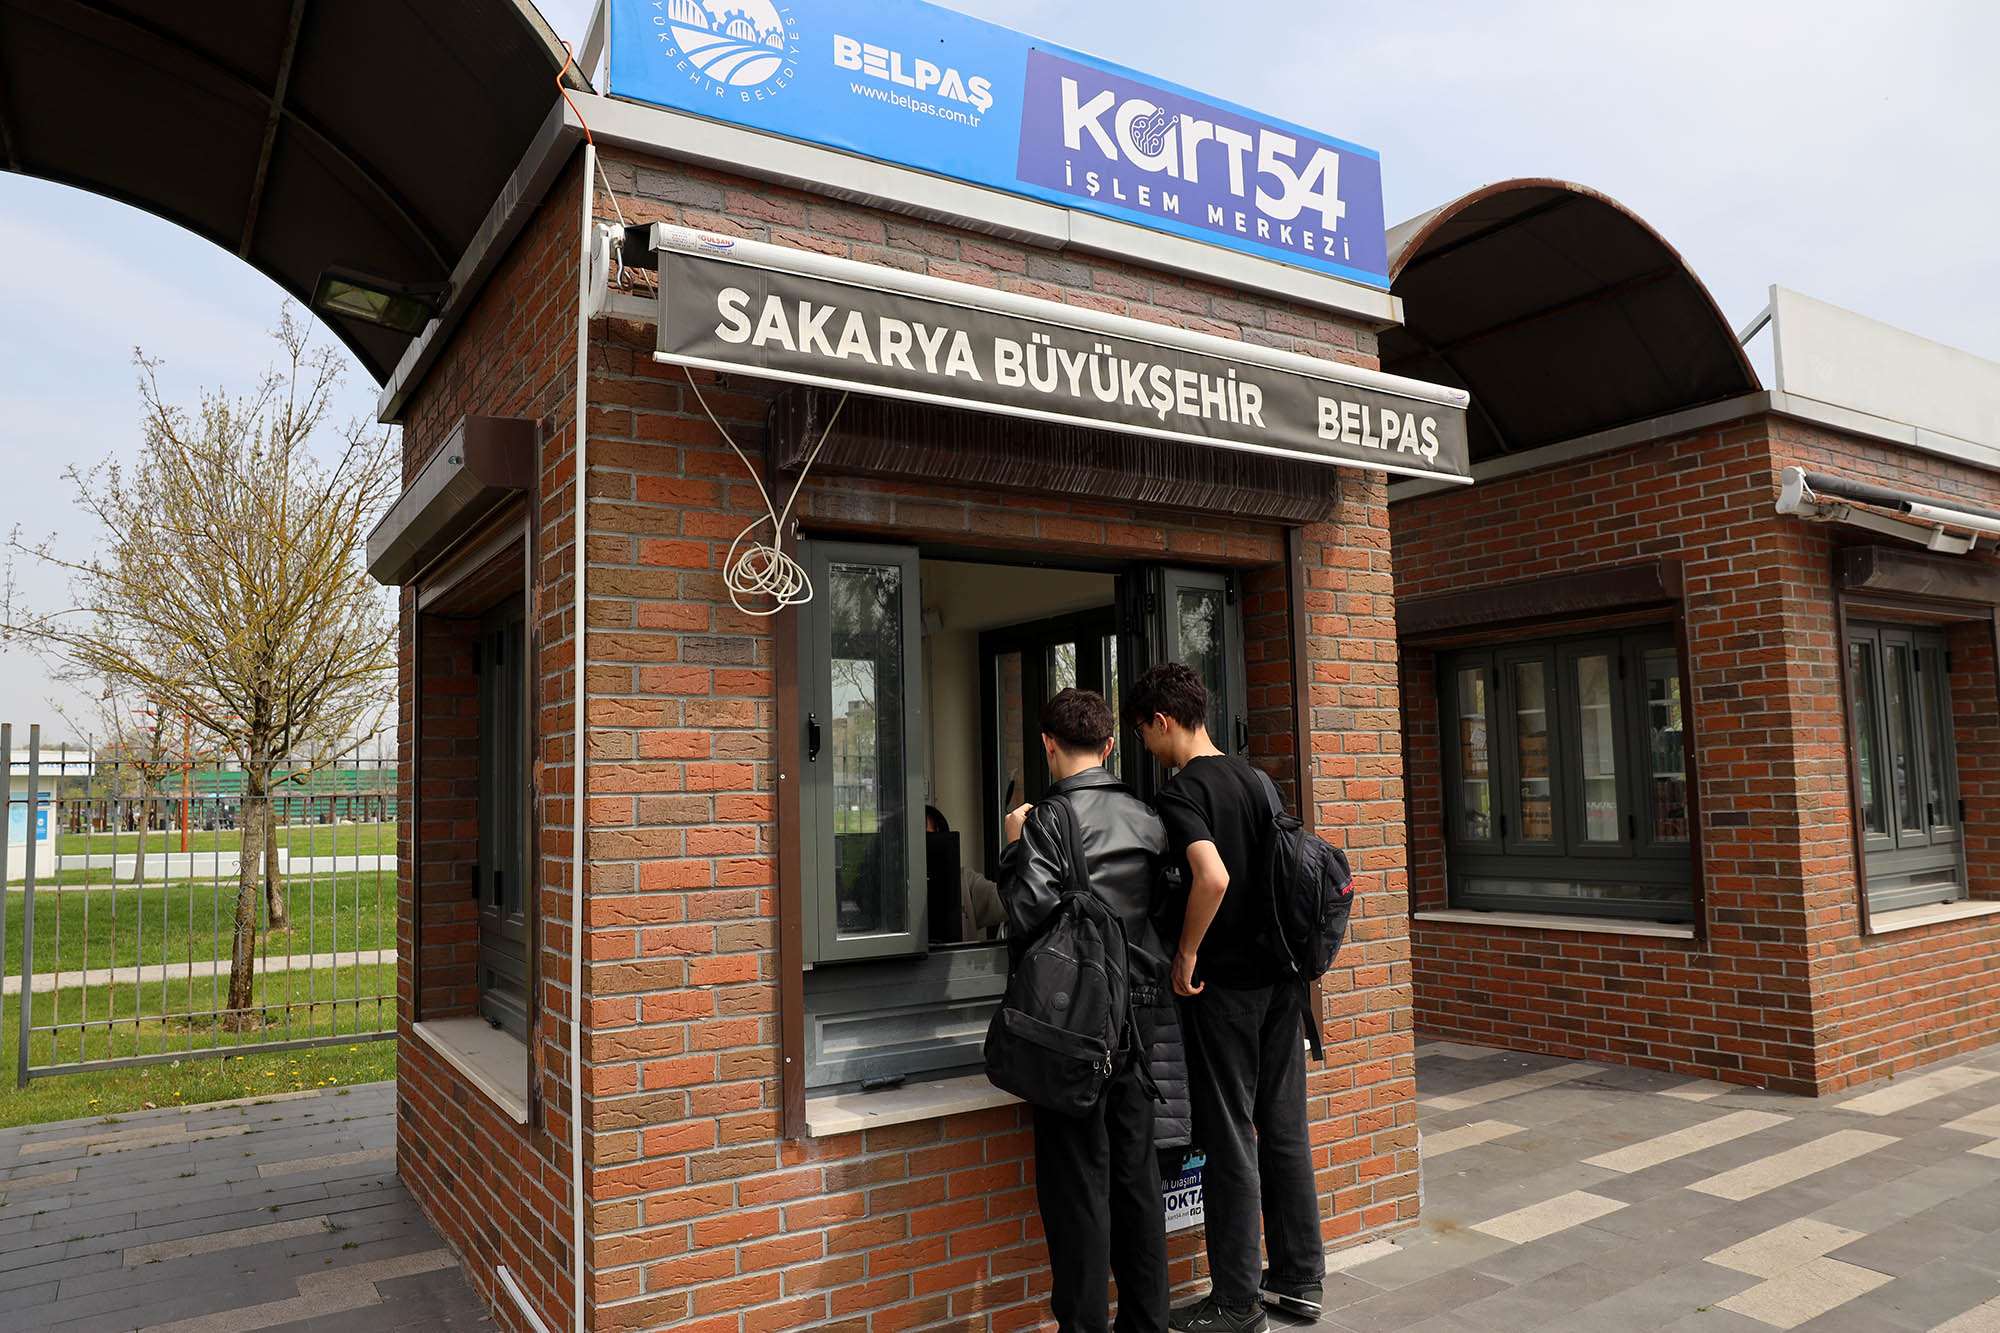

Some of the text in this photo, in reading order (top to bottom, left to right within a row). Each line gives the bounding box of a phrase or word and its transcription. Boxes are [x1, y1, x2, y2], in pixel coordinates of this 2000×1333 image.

[833, 34, 994, 114] BELPAŞ
[850, 80, 981, 128] www.belpas.com.tr
[1065, 160, 1350, 260] İŞLEM MERKEZİ
[715, 287, 1439, 465] SAKARYA BÜYÜKŞEHİR BELPAŞ
